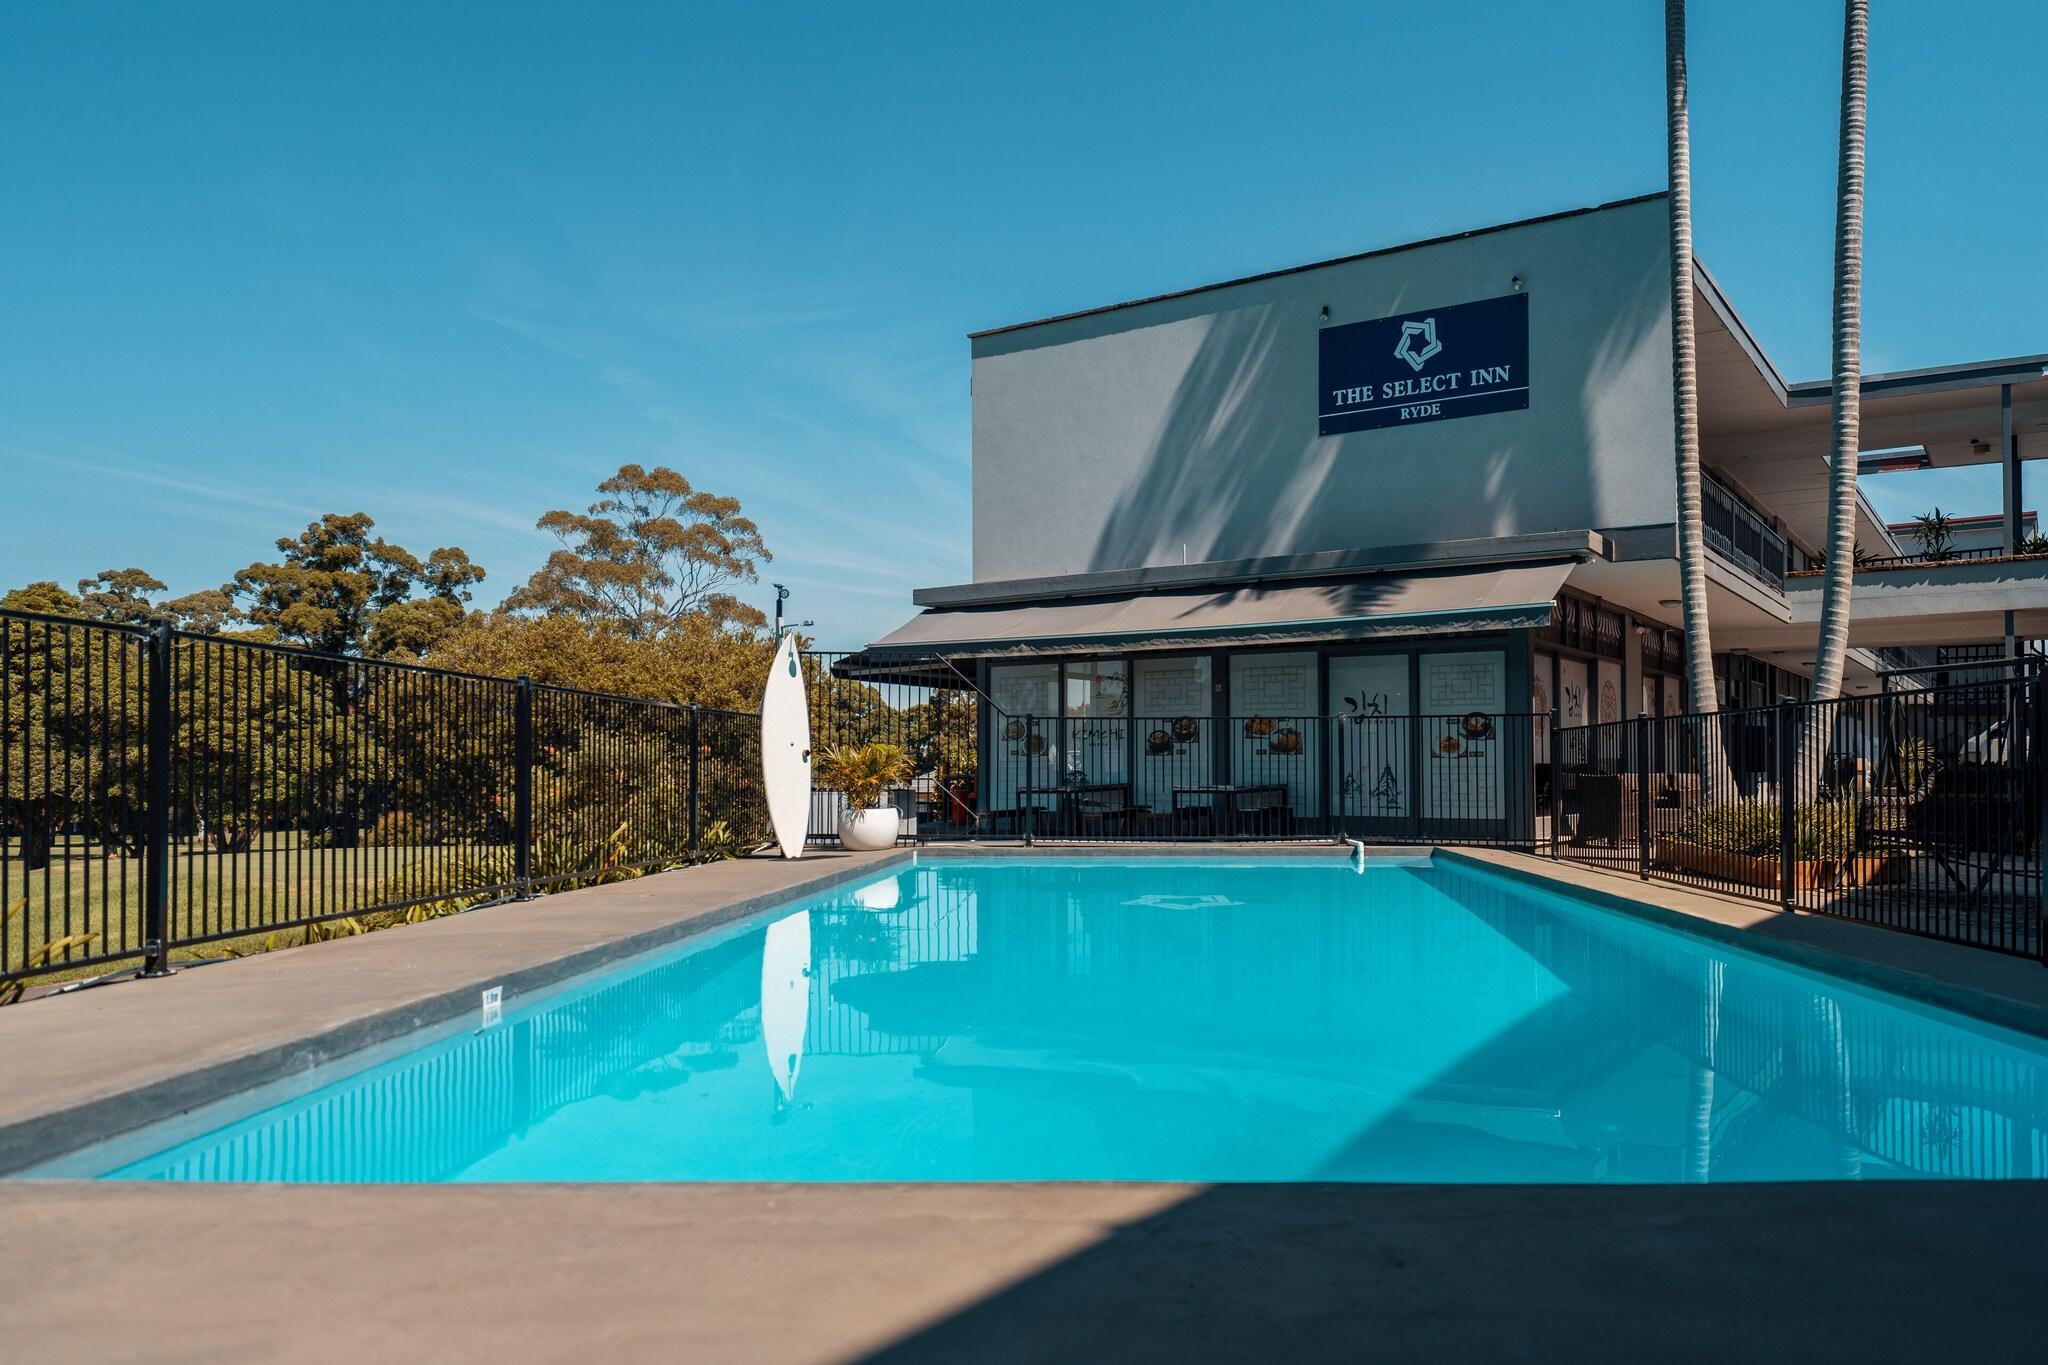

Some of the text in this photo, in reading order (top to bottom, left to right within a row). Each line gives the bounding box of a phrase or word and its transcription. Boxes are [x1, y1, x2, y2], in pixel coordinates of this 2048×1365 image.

[1332, 365, 1511, 406] THE SELECT INN
[1400, 403, 1441, 420] RYDE
